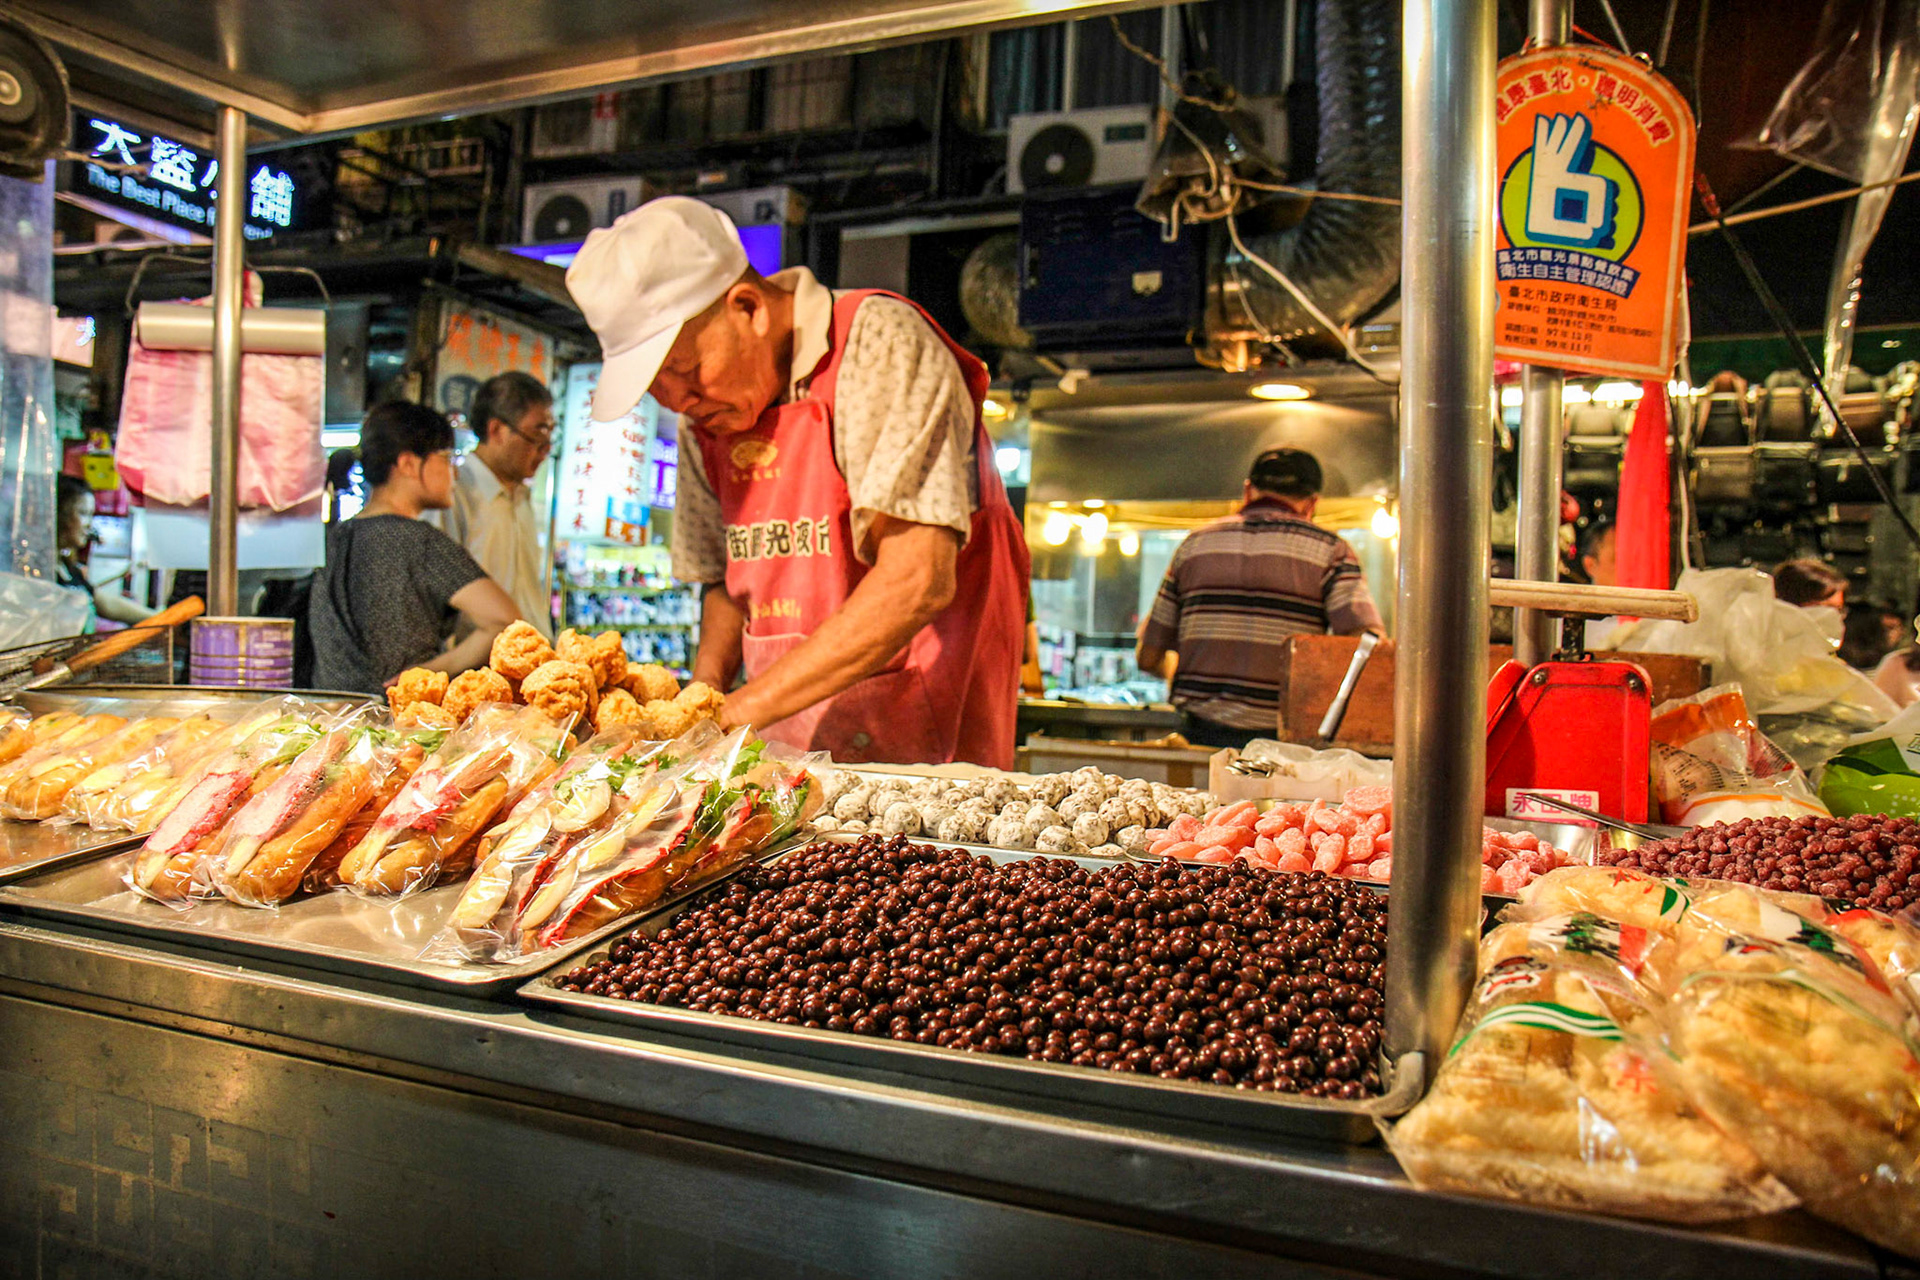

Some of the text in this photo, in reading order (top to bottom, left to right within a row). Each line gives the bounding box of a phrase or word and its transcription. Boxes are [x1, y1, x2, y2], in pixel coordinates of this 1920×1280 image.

[86, 163, 121, 194] The
[122, 175, 160, 208] Best
[161, 190, 206, 223] Place
[1500, 263, 1629, 296] 衛生自主管理認證
[1508, 286, 1618, 311] 臺北市政府衛生局
[1512, 791, 1594, 815] 永田牌
